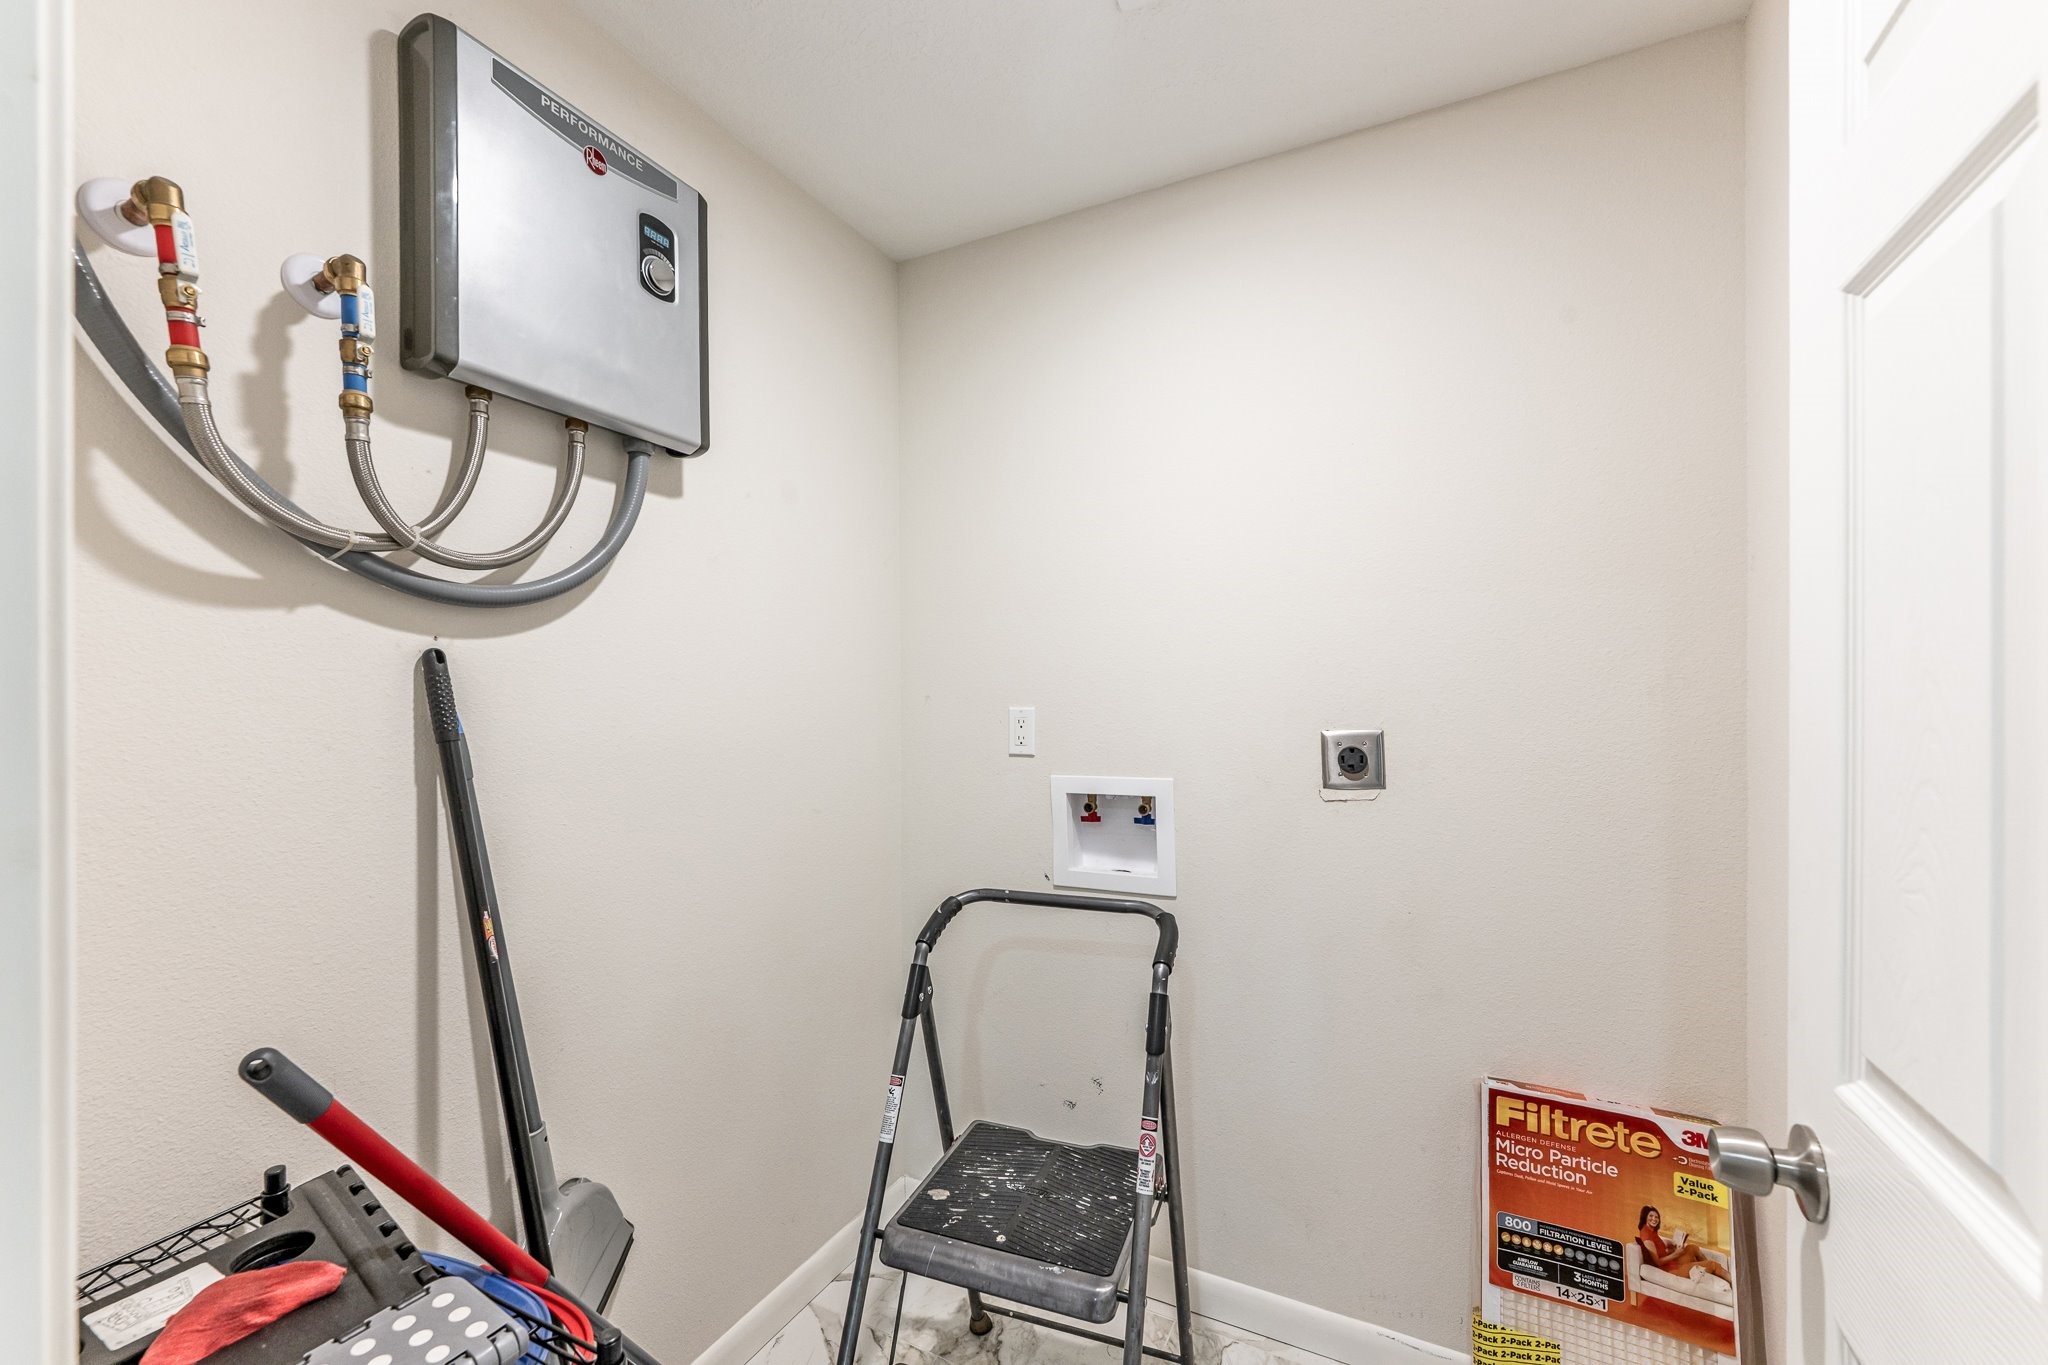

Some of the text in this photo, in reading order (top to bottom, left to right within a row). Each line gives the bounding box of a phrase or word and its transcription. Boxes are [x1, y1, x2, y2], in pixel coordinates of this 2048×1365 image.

[541, 94, 644, 172] PERFORMANCE
[585, 146, 607, 174] Rheem
[1496, 1096, 1661, 1158] Filtrete
[1496, 1130, 1577, 1152] ALLERGEN DEFENSE
[1496, 1138, 1618, 1177] Micro Particle
[1496, 1152, 1587, 1185] Reduction
[1680, 1176, 1714, 1191] Value
[1677, 1185, 1719, 1202] 2-Pack
[1505, 1216, 1531, 1231] 800
[1539, 1228, 1585, 1245] FILTRATION
[1512, 1260, 1543, 1272] GUARANTEED
[1517, 1257, 1538, 1266] AIRFLOW
[1520, 1282, 1541, 1291] FILTERS
[1573, 1271, 1581, 1282] 3
[1581, 1278, 1609, 1290] MONTHS
[1500, 1336, 1532, 1347] 2-Pack
[1500, 1350, 1532, 1361] 2-Pack
